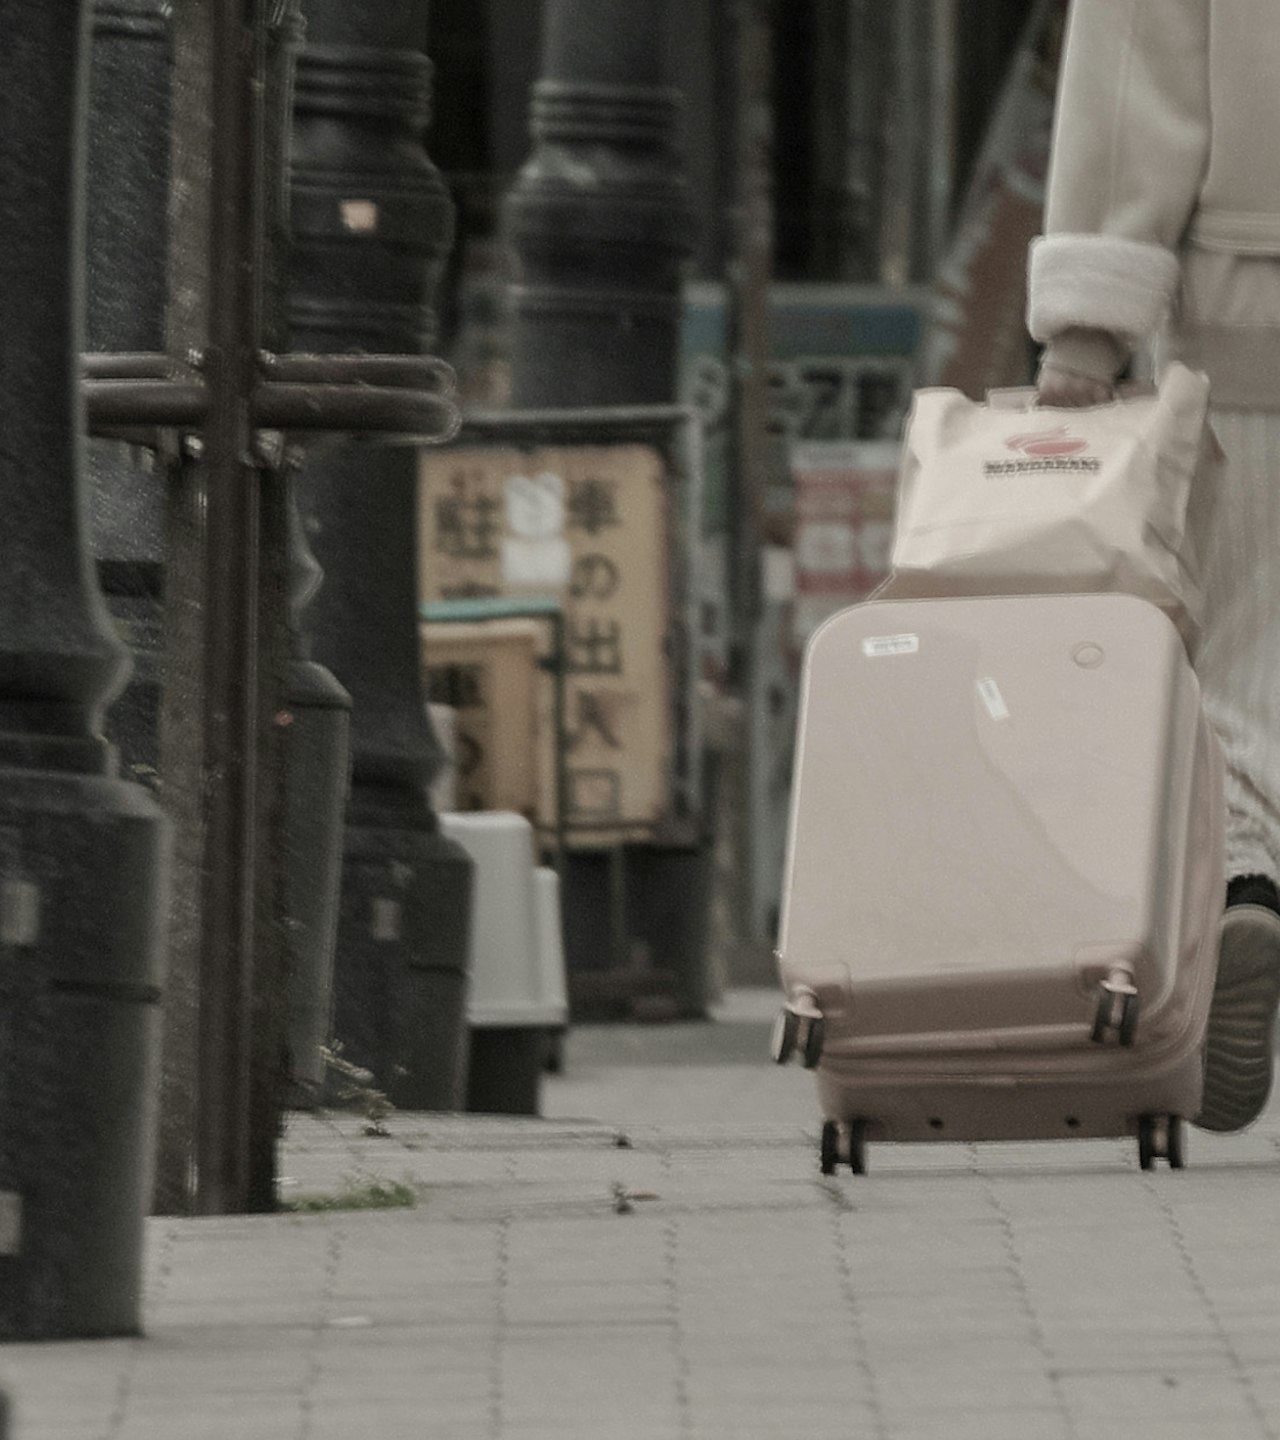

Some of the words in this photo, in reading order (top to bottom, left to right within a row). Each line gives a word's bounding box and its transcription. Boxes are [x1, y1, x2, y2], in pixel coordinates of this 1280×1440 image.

[564, 477, 624, 824] 車の出入口
